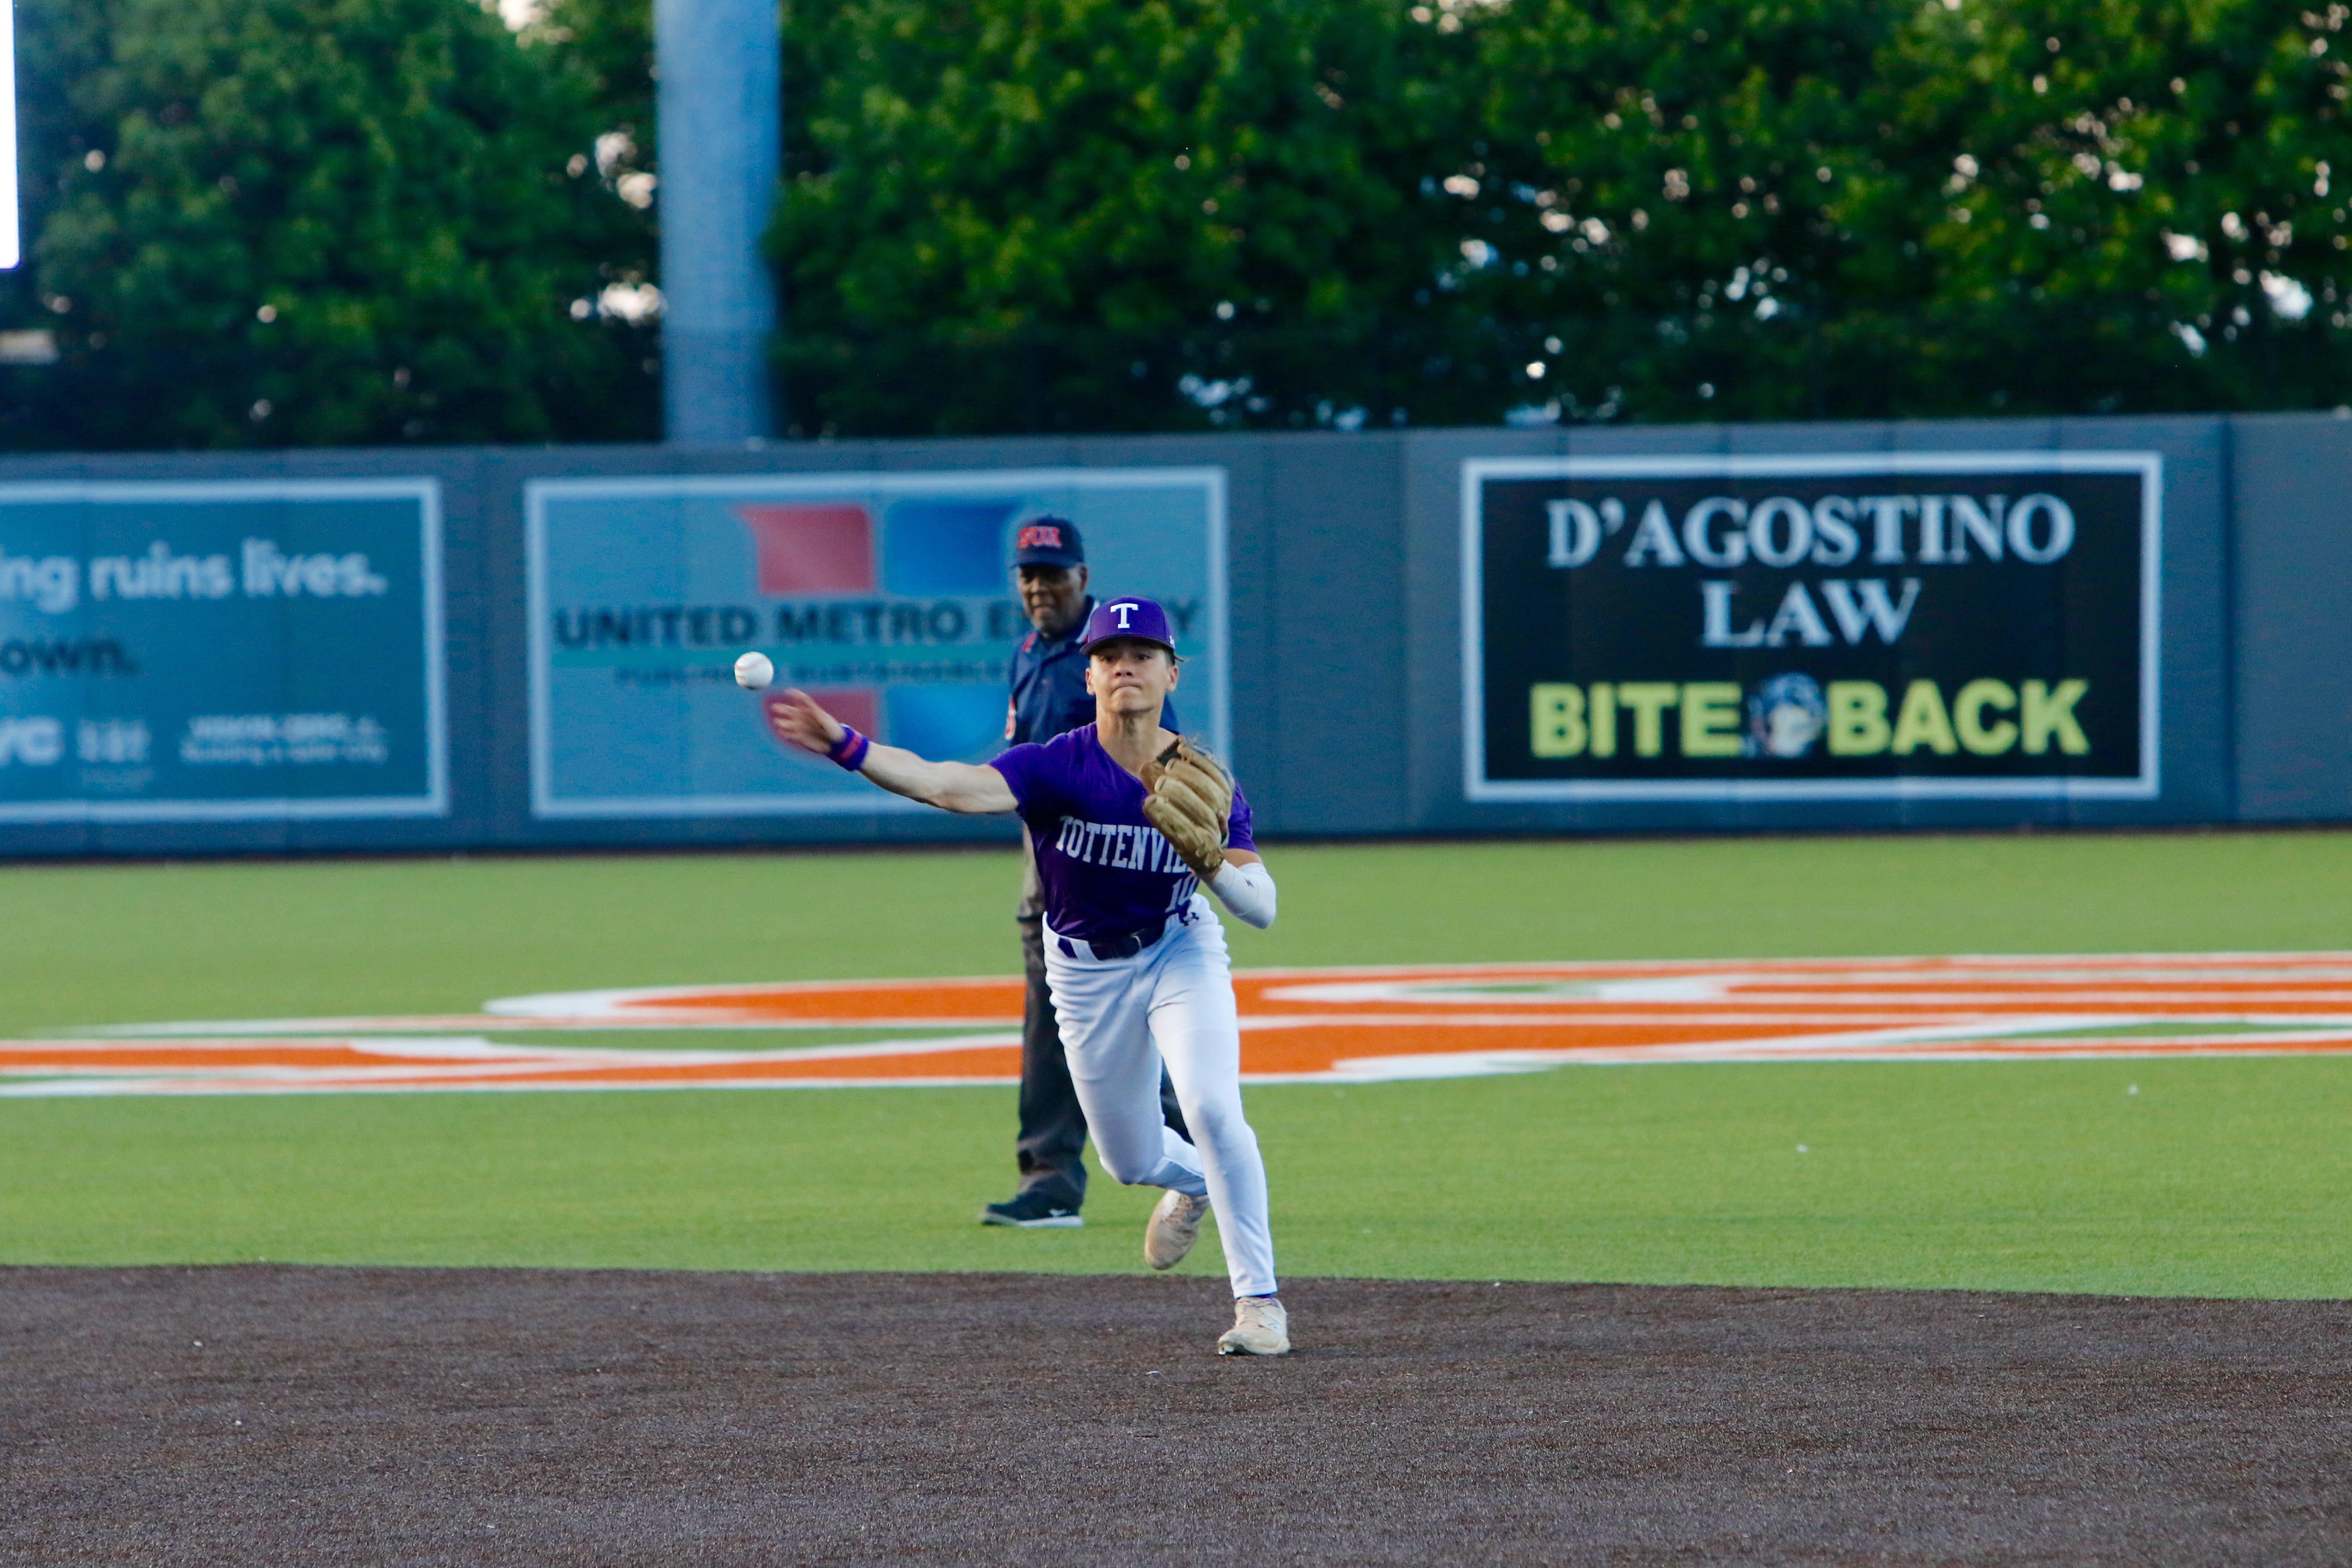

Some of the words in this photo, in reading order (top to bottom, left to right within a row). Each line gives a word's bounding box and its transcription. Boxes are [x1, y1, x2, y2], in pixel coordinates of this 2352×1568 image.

[1546, 493, 2075, 567] D'AGOSTINO
[0, 555, 78, 612] ng
[91, 541, 233, 597] ruins
[242, 537, 387, 597] lives.
[557, 604, 757, 645] UNITED
[779, 602, 965, 643] METRO
[1110, 603, 1139, 629] T
[1700, 579, 1921, 648] LAW
[1529, 682, 1742, 758] BITE
[1827, 678, 2090, 756] BACK
[1056, 815, 1194, 873] TOTTENVIL
